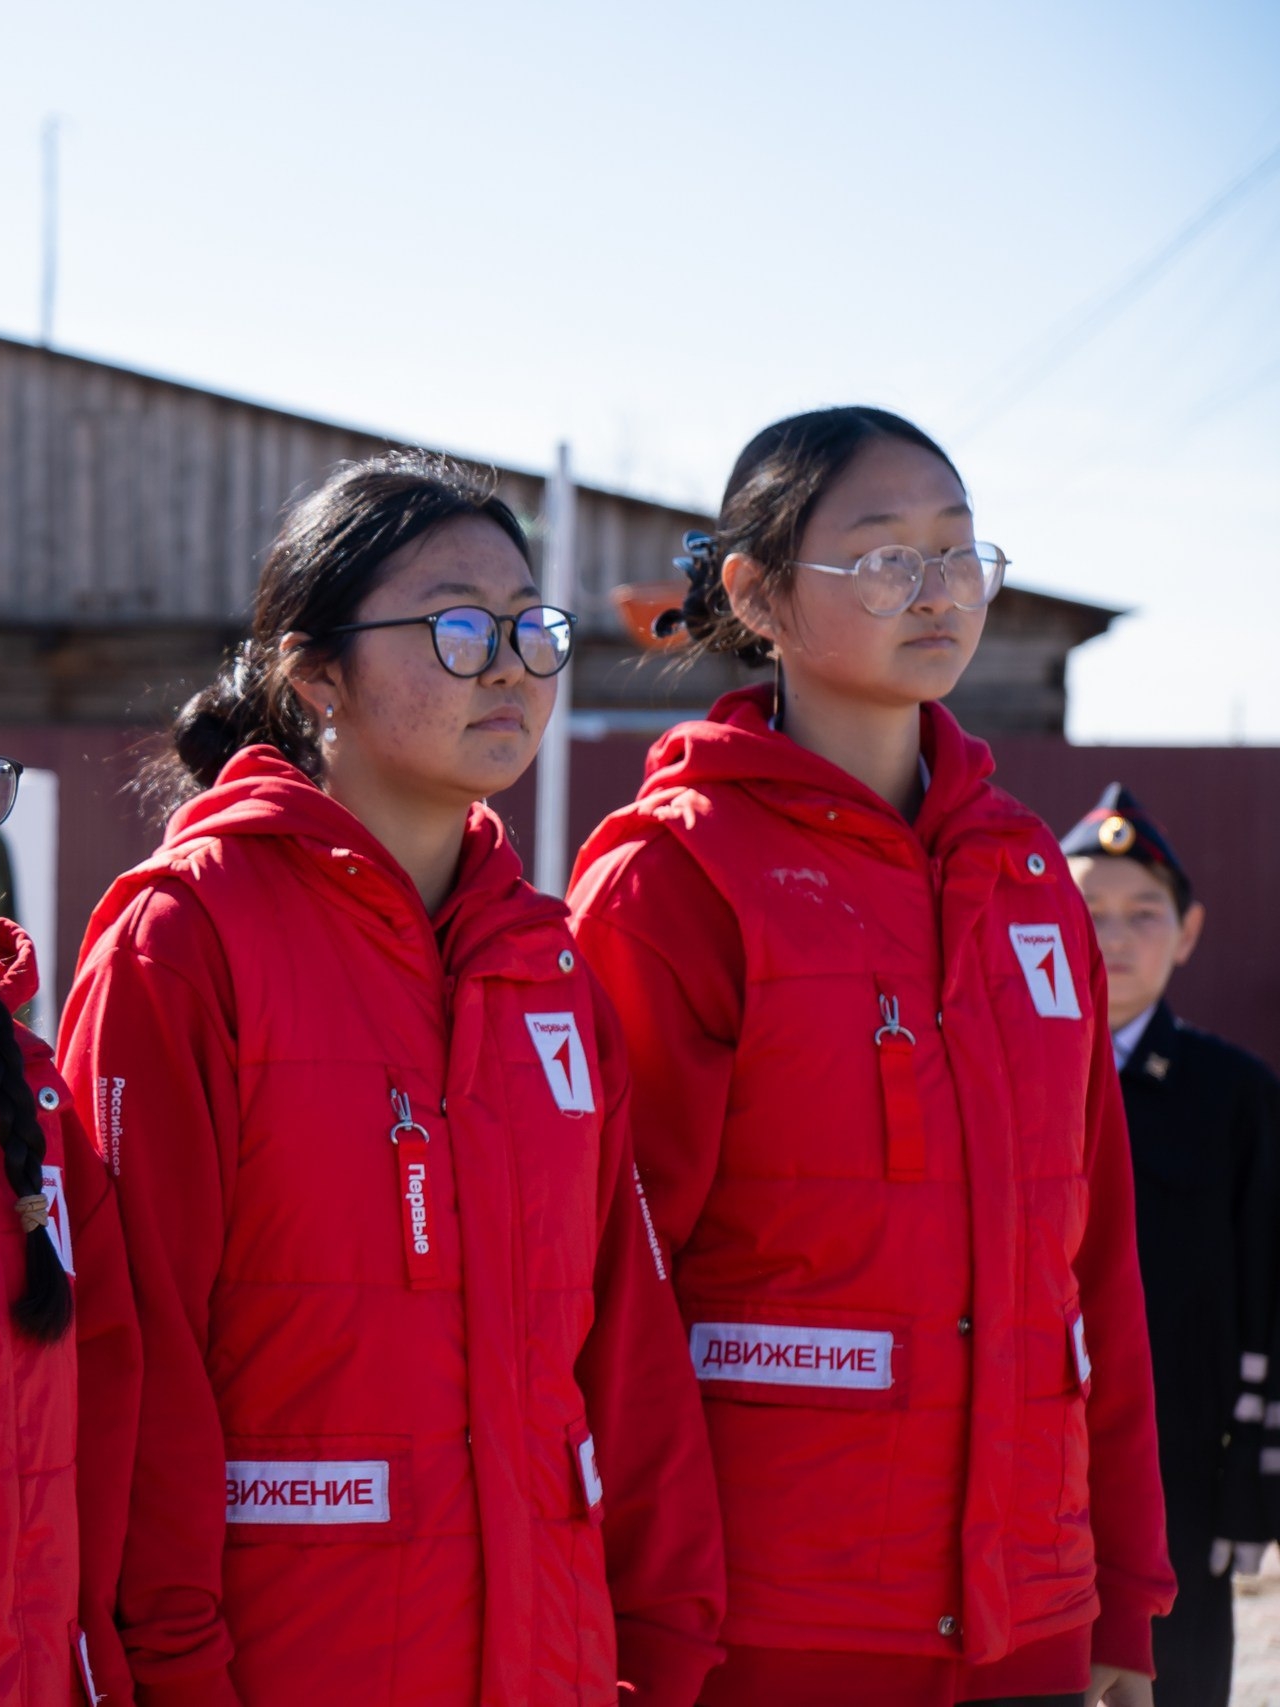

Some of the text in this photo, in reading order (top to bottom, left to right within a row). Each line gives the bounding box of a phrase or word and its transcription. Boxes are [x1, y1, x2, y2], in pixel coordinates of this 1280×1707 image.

[111, 1076, 126, 1176] Российское
[405, 1163, 430, 1254] Первые
[702, 1340, 877, 1373] ДВИЖЕНИЕ
[226, 1479, 374, 1506] ВИЖЕНИЕ
